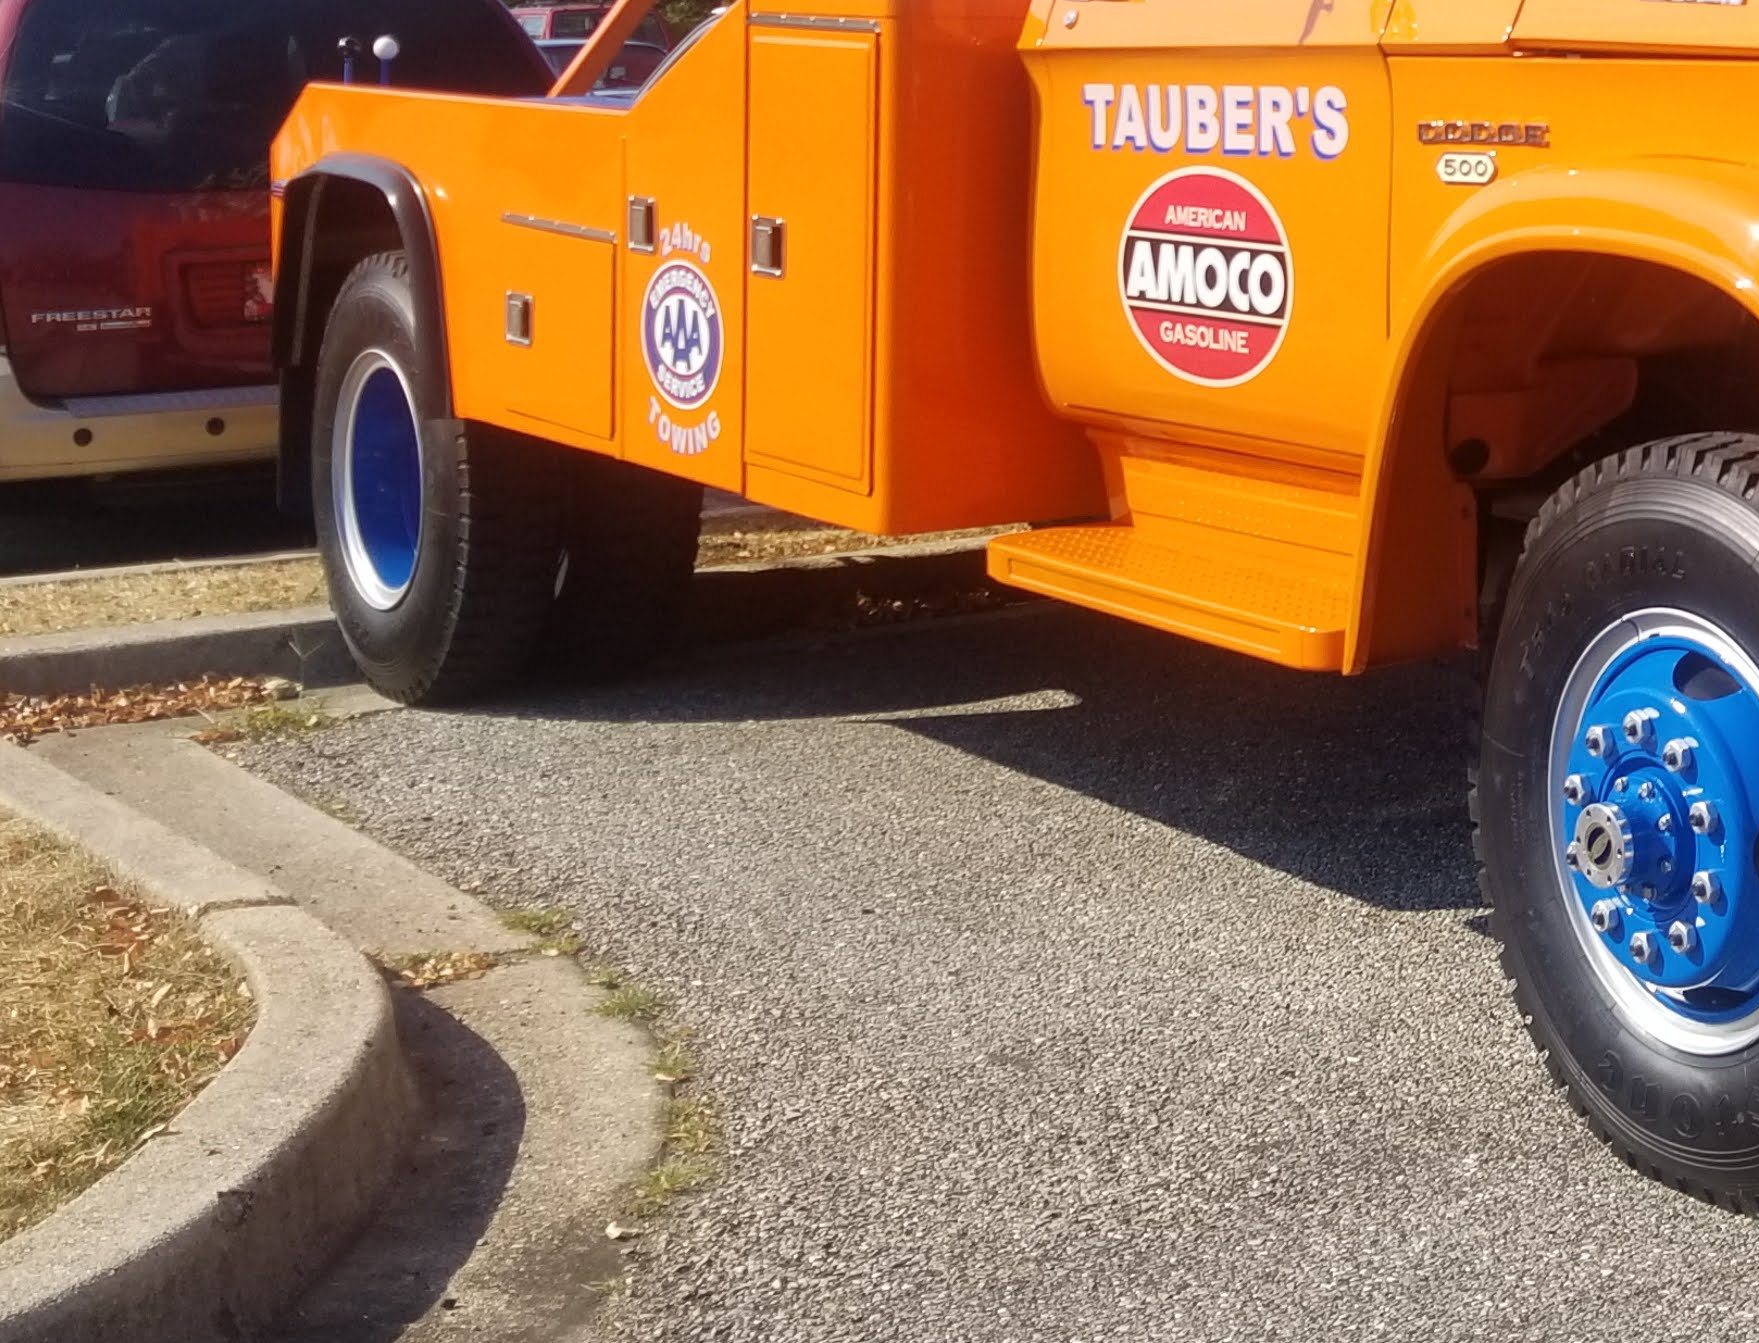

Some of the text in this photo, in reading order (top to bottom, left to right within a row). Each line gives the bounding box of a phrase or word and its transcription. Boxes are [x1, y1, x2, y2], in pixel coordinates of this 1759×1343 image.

[1081, 82, 1350, 161] TAUBER'S
[1416, 120, 1551, 148] DODGE
[1443, 158, 1489, 178] 500
[1164, 204, 1248, 233] AMERICAN
[658, 222, 712, 264] 24hrs
[649, 267, 716, 319] EMERGENCY
[1126, 239, 1286, 316] AMOCO
[30, 306, 152, 324] FREESTAR
[660, 297, 704, 373] AAA
[1159, 320, 1251, 356] GASOLINE
[656, 362, 706, 399] SERVICE
[647, 394, 721, 455] TOWING
